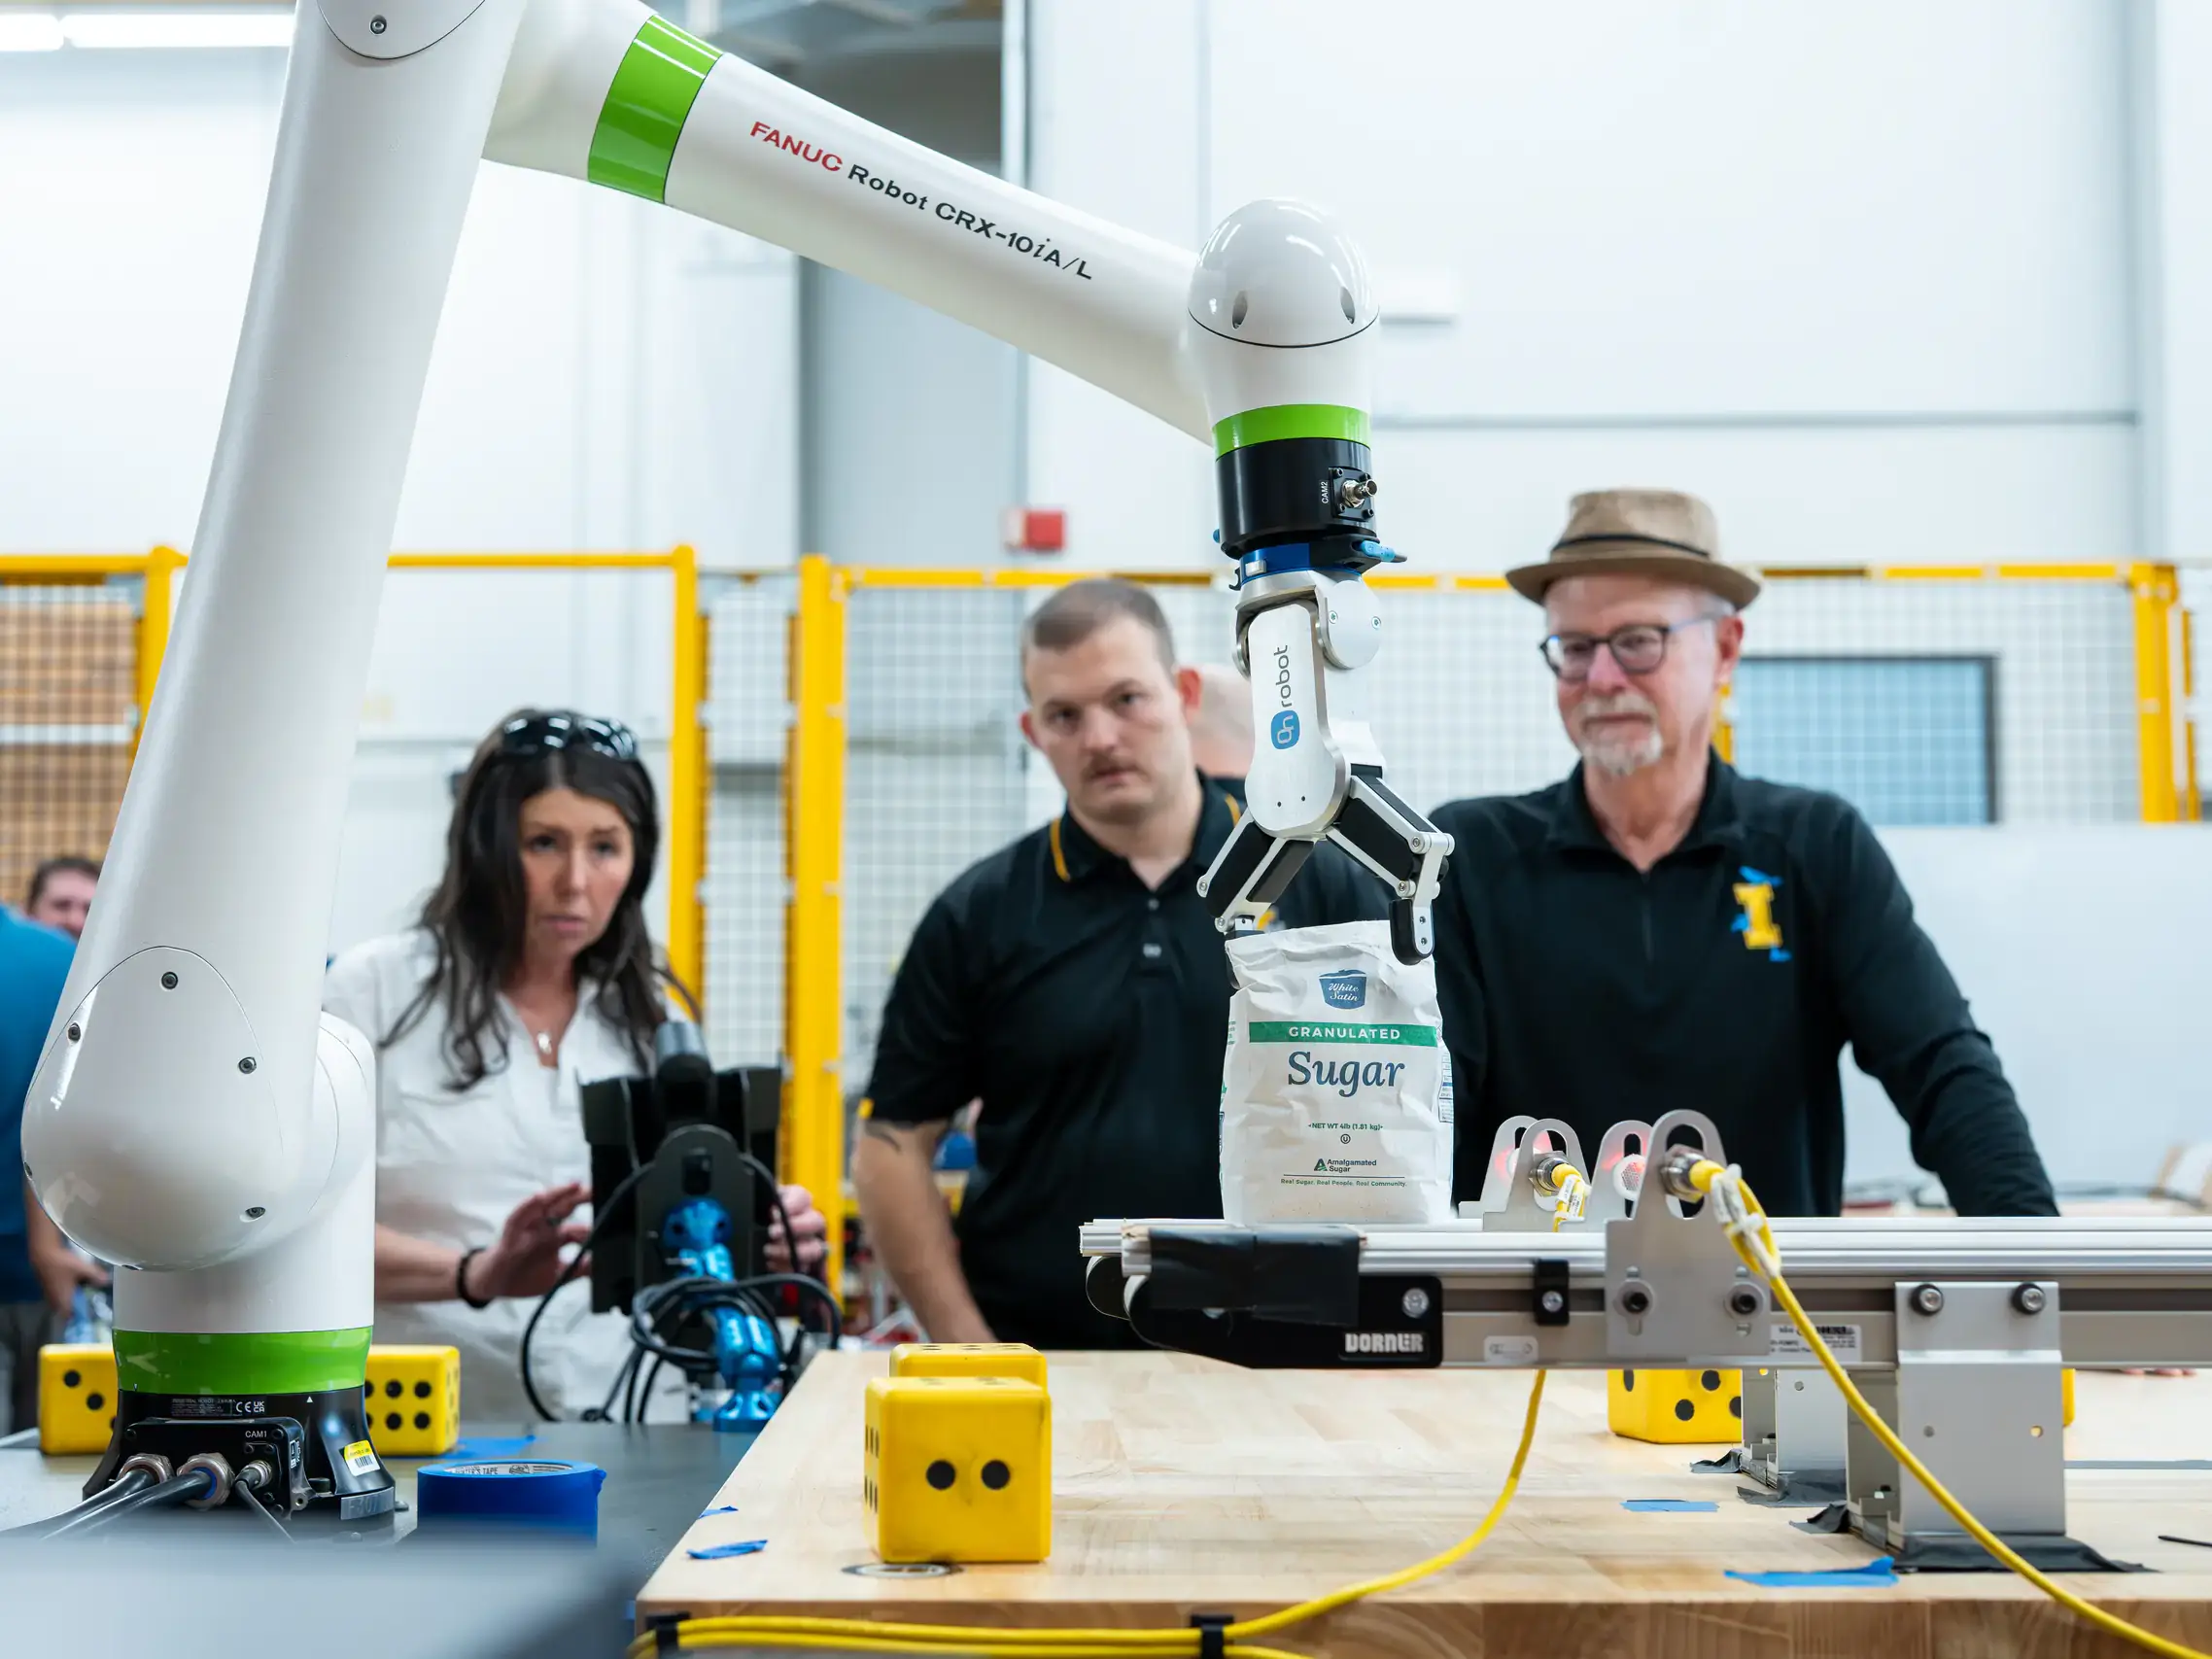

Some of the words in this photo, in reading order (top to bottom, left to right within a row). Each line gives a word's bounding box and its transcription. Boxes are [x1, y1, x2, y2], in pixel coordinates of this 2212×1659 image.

[750, 121, 843, 172] FANUC
[847, 164, 928, 210] Robot
[935, 202, 1092, 280] CRX-10iA/L
[1328, 983, 1359, 992] White
[1330, 990, 1358, 1001] Satin
[1288, 1026, 1400, 1040] GRANULATED
[1288, 1051, 1405, 1097] Sugar
[1345, 1333, 1424, 1352] DORNER
[245, 1430, 267, 1438] CAM1
[483, 1466, 499, 1475] TAPE
